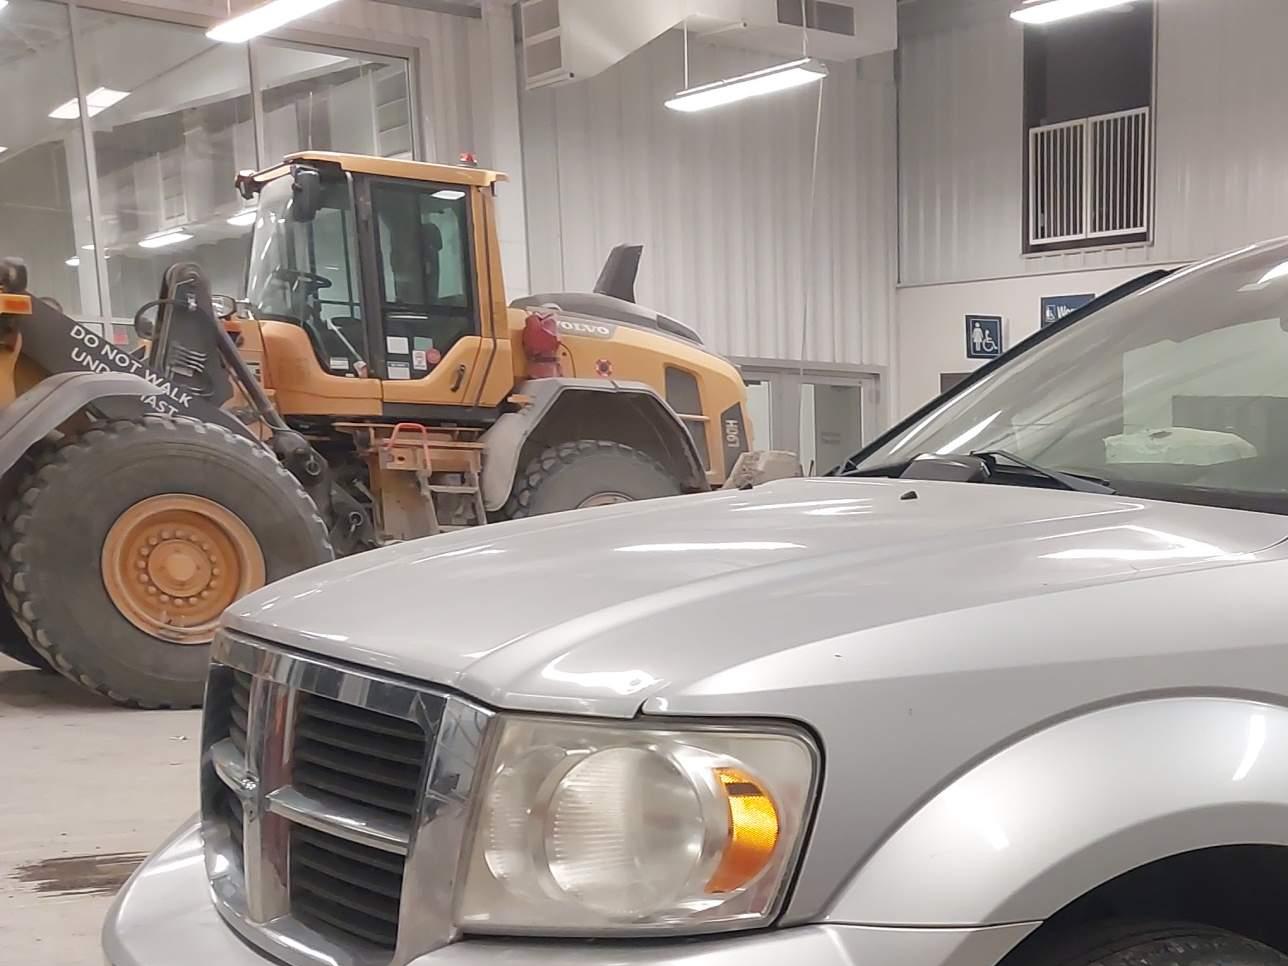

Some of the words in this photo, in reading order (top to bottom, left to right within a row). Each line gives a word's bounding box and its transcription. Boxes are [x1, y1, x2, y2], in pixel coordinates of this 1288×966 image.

[70, 325, 99, 348] DO
[101, 344, 142, 373] NOT
[144, 369, 193, 408] WALK
